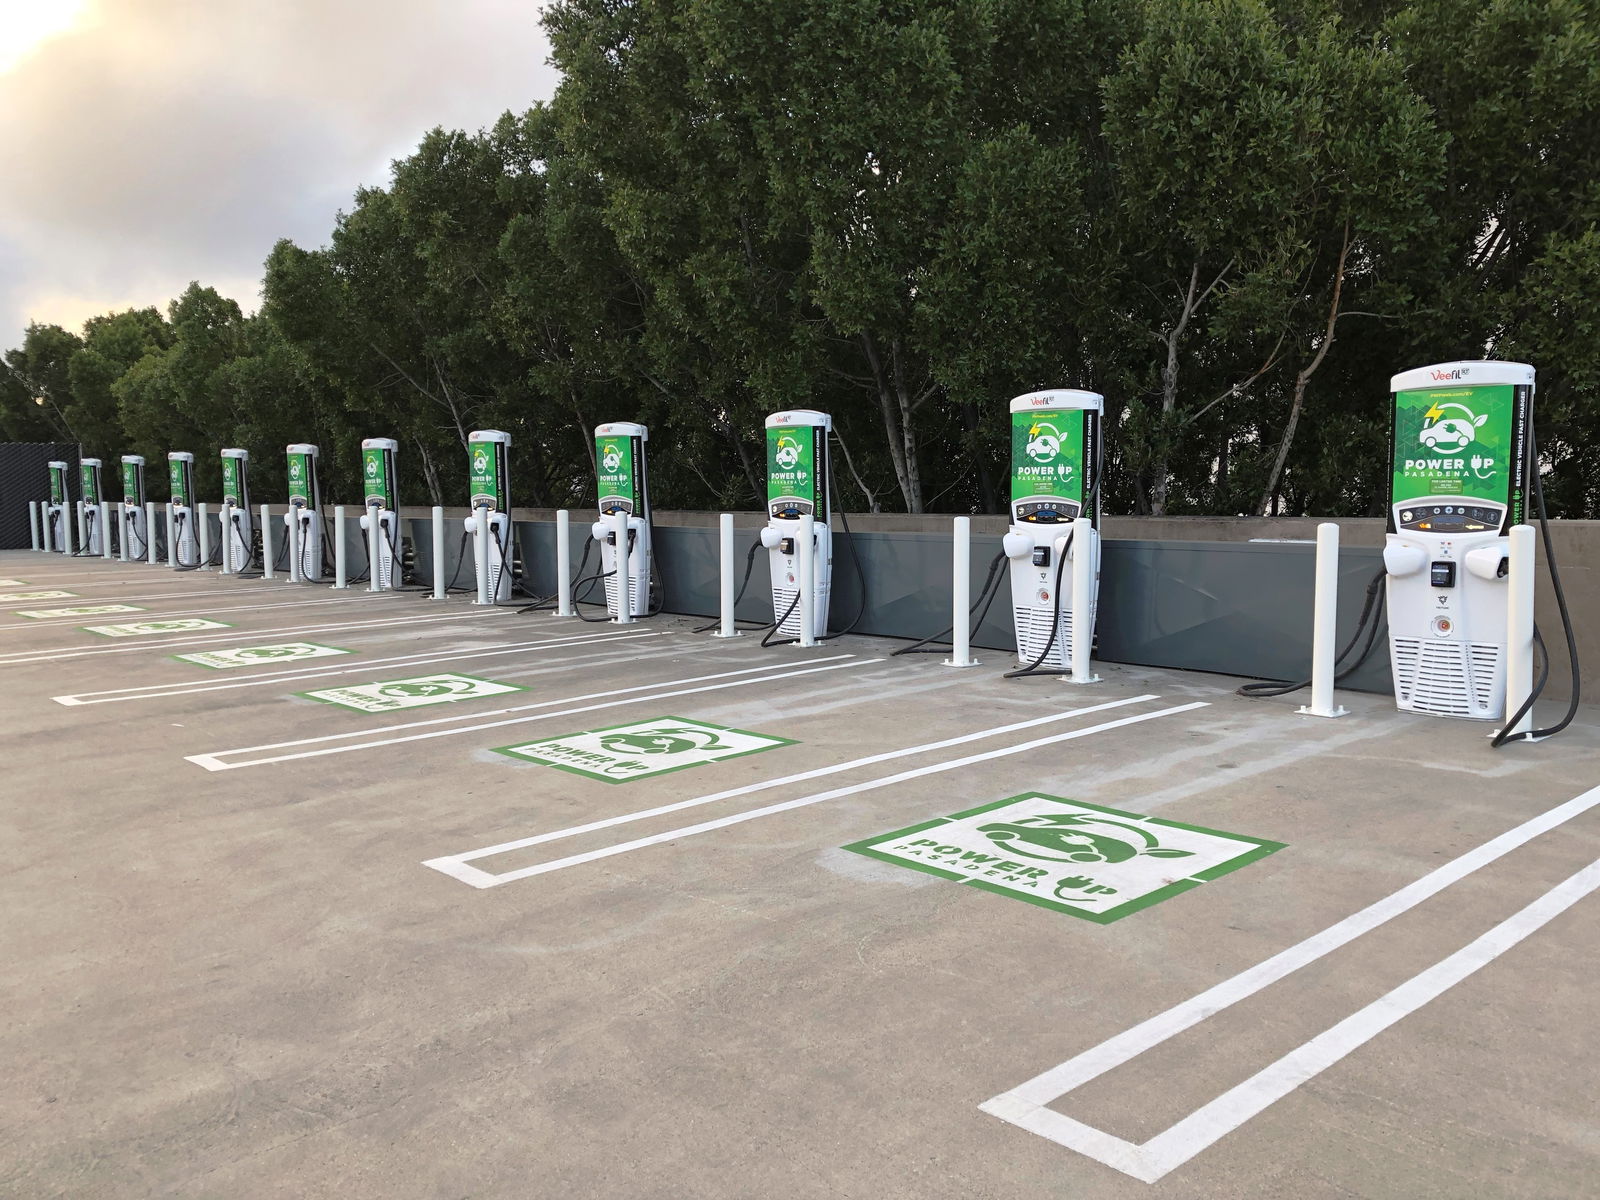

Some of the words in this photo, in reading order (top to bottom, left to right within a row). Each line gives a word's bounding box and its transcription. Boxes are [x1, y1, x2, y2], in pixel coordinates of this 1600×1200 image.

[1430, 369, 1462, 381] Veefil
[1018, 466, 1054, 475] POWER
[1405, 459, 1465, 470] POWER
[1470, 454, 1495, 474] UP
[771, 472, 795, 480] POWER
[540, 743, 617, 763] POWER
[893, 845, 1038, 888] PASADENA
[909, 838, 1049, 879] POWER
